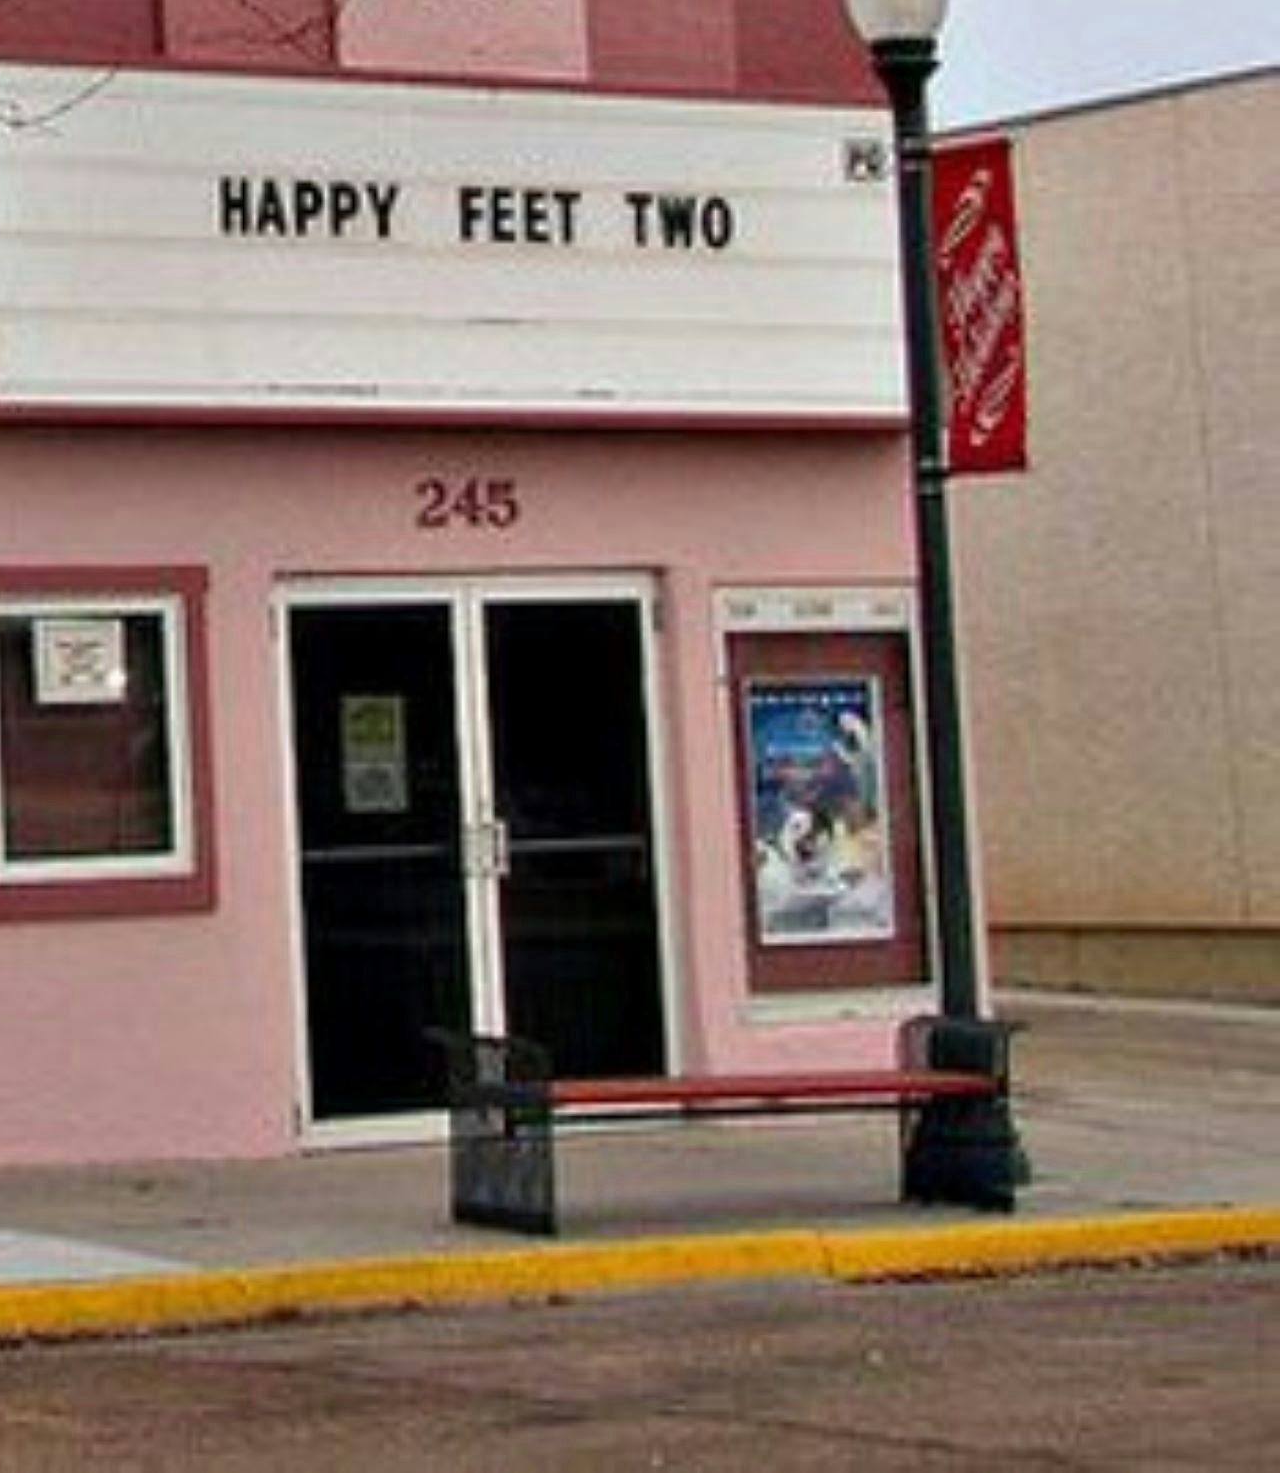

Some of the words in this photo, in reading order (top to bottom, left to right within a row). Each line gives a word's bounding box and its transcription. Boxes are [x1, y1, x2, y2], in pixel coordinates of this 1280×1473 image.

[220, 175, 400, 239] HAPPY
[459, 185, 583, 244] FEET
[626, 191, 734, 250] TWO
[416, 477, 517, 528] 245
